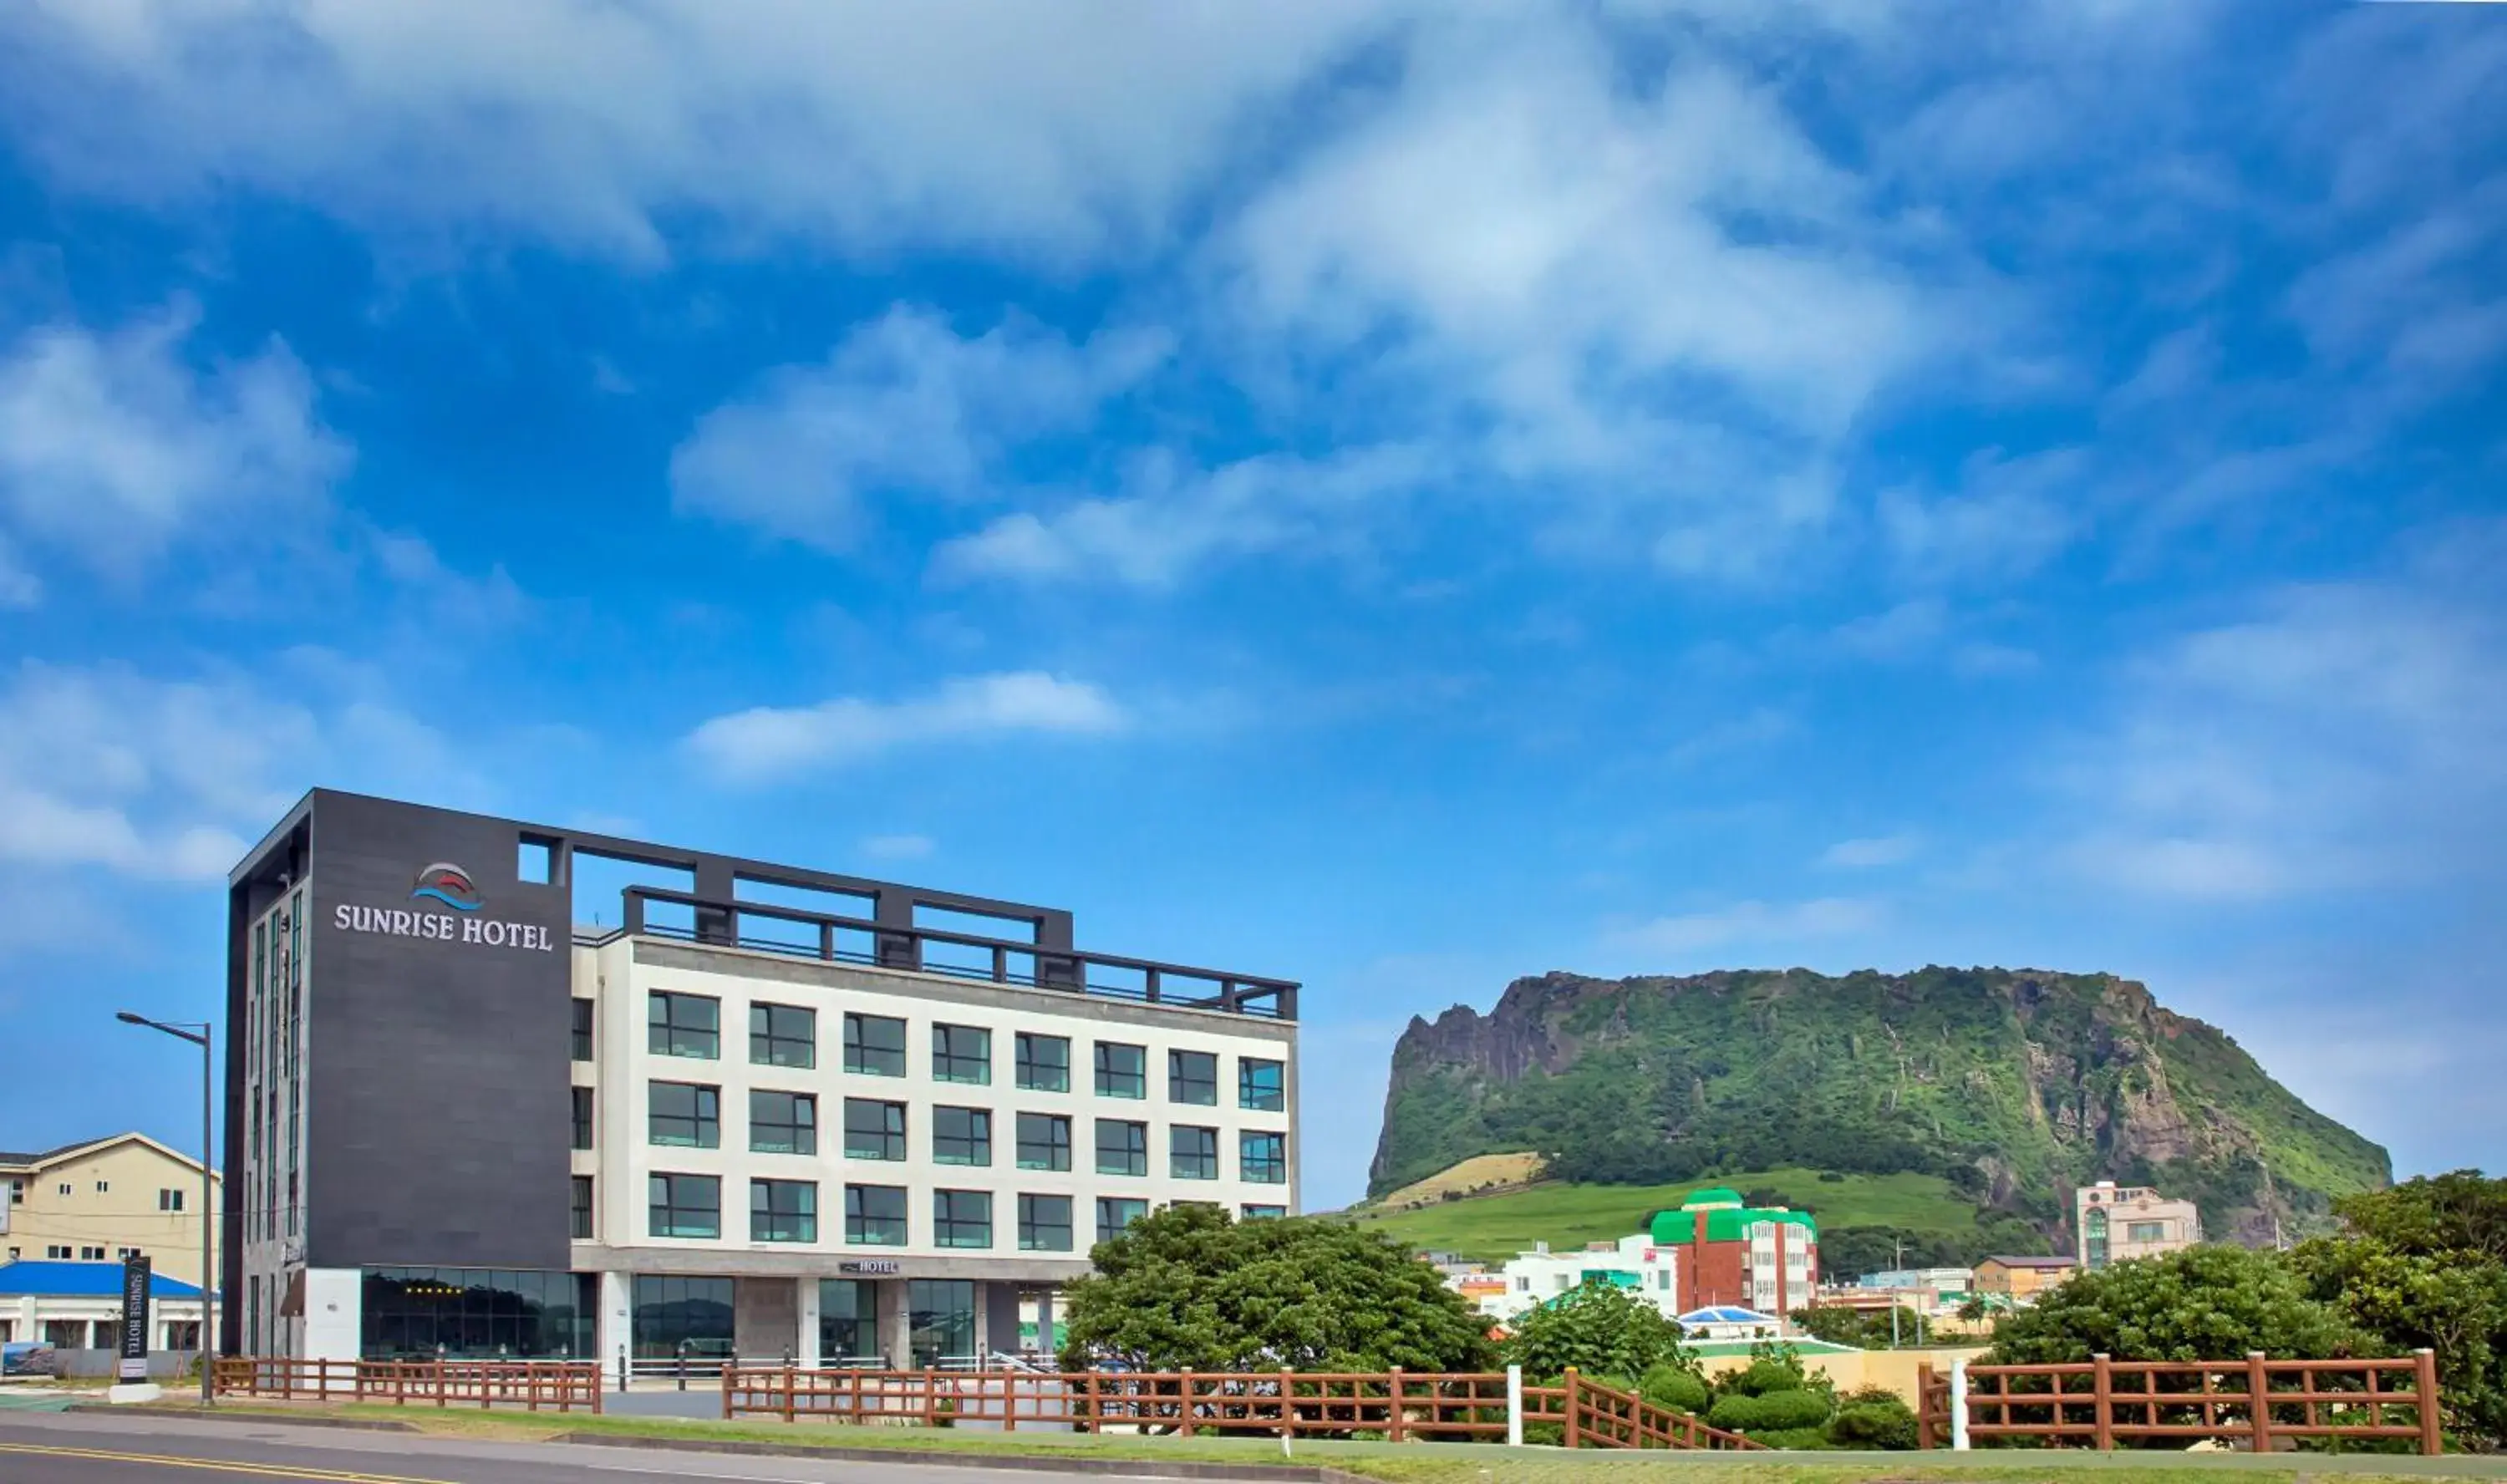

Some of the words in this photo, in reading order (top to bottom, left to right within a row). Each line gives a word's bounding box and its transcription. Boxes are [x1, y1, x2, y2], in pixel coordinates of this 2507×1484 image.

[334, 904, 455, 940] SUNRISE
[462, 917, 552, 952] HOTEL
[860, 1260, 897, 1272] HOTEL
[128, 1320, 140, 1355] HOTEL
